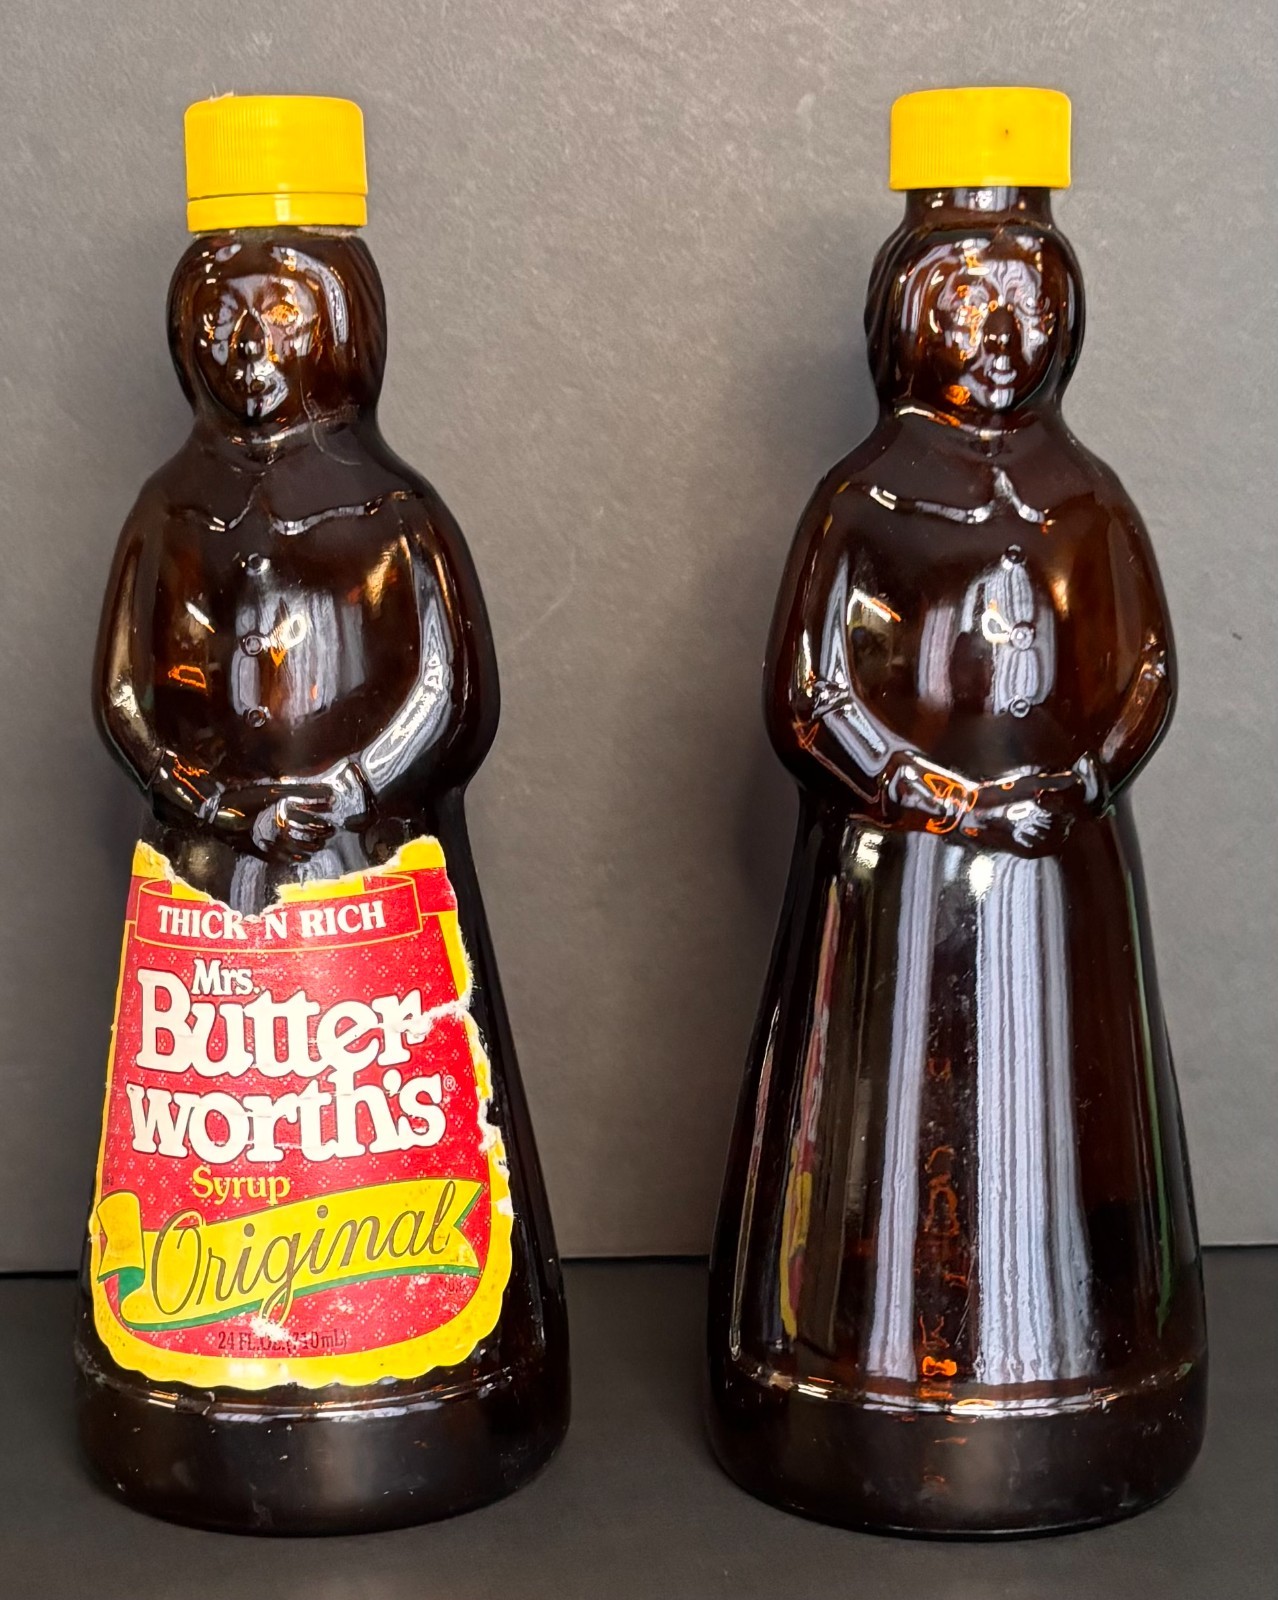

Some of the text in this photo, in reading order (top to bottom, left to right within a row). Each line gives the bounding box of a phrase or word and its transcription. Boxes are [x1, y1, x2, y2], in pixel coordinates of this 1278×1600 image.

[300, 900, 386, 939] RICH
[191, 957, 260, 995] Mrs.
[136, 967, 426, 1077] Butter
[126, 1067, 447, 1164] worth's
[192, 1165, 291, 1206] Syrup
[151, 1180, 457, 1328] Original
[218, 1331, 235, 1350] 24
